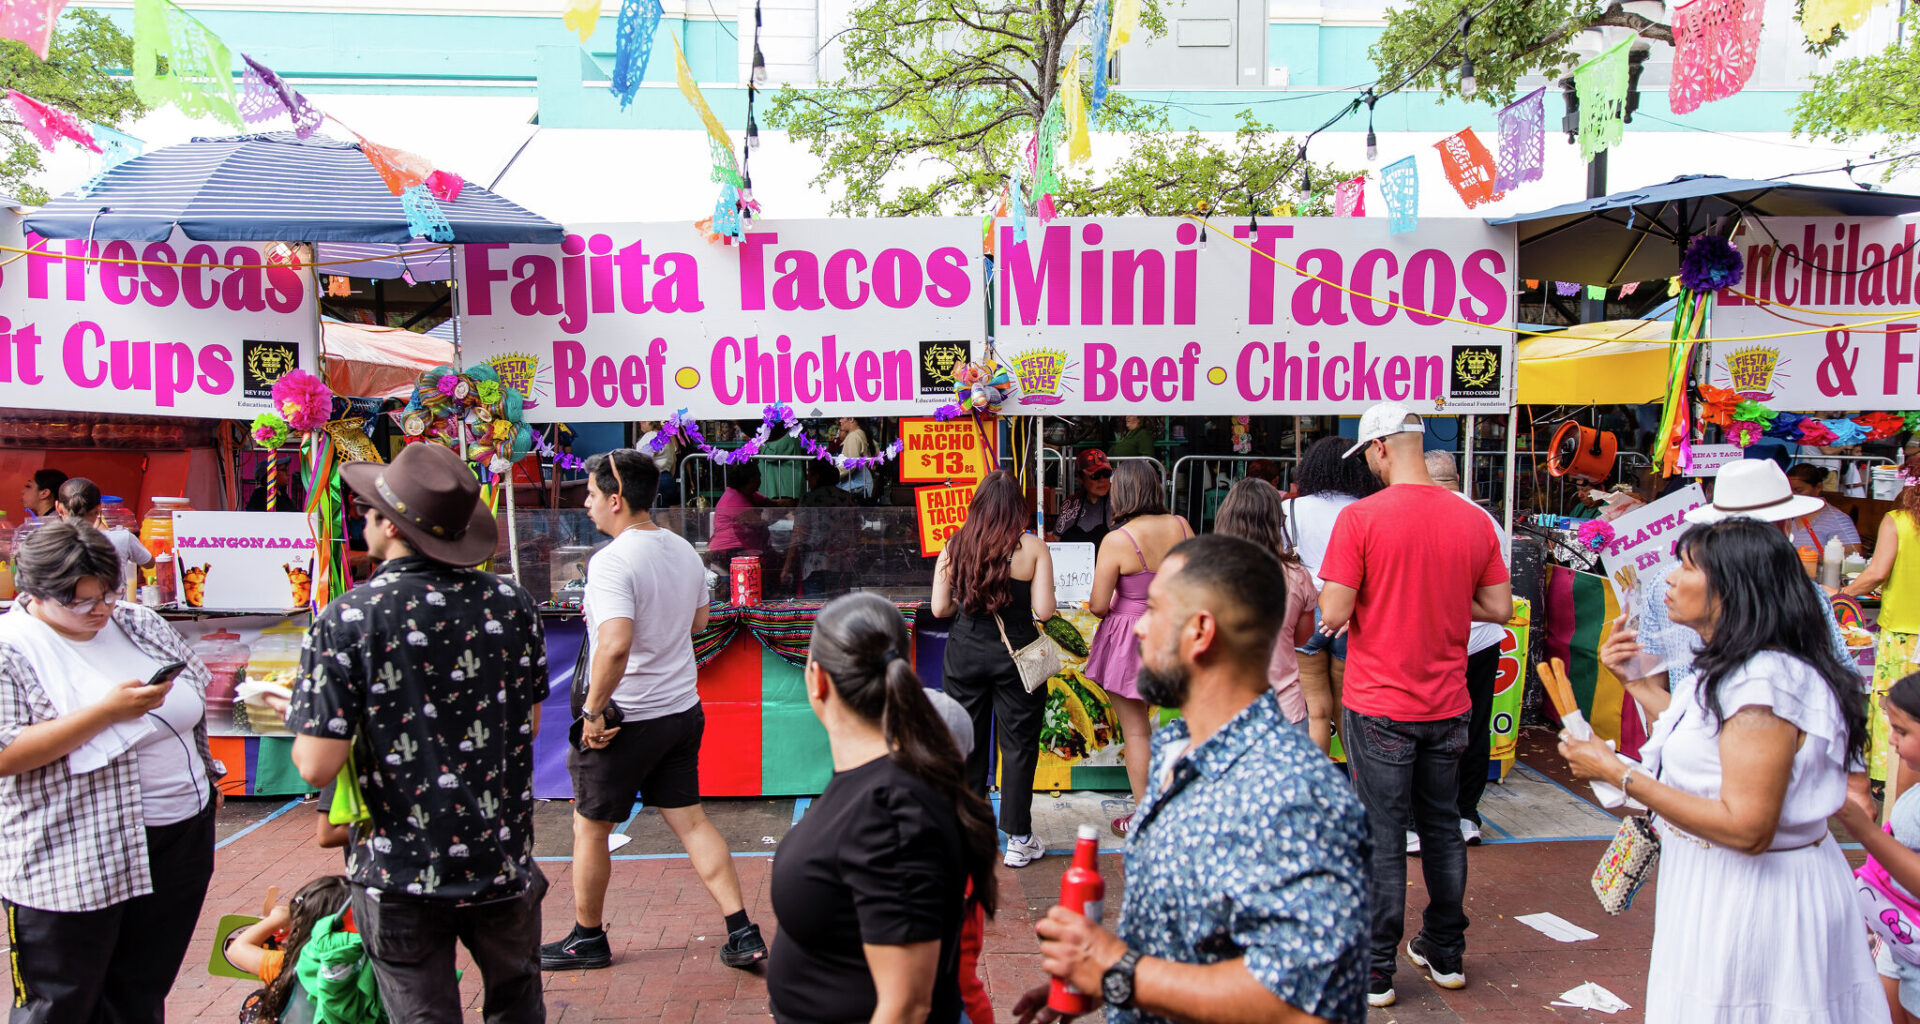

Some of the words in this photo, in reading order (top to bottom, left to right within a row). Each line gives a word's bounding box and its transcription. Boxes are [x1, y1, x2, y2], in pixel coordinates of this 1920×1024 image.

[26, 231, 304, 314] Frescas
[1000, 222, 1197, 326] Mini
[1233, 224, 1507, 326] Tacos
[1717, 224, 1920, 308] nchilad
[464, 234, 704, 334] Fajita
[721, 232, 971, 311] Tacos
[62, 320, 235, 407] Cups
[552, 337, 668, 408] Beef
[710, 334, 914, 406] Chicken
[1020, 356, 1054, 371] FIESTA
[1735, 353, 1768, 369] FIESTA
[1816, 323, 1859, 397] &
[1882, 323, 1920, 395] F
[1083, 341, 1201, 402] Beef
[1235, 341, 1444, 402] Chicken
[500, 380, 529, 394] EYES
[924, 424, 973, 432] SUPER
[909, 433, 975, 451] NACHO
[921, 452, 964, 474] $13
[964, 465, 976, 473] ea.
[927, 488, 974, 508] FAJITA
[177, 536, 316, 549] MANGONADAS
[1636, 551, 1661, 570] IN
